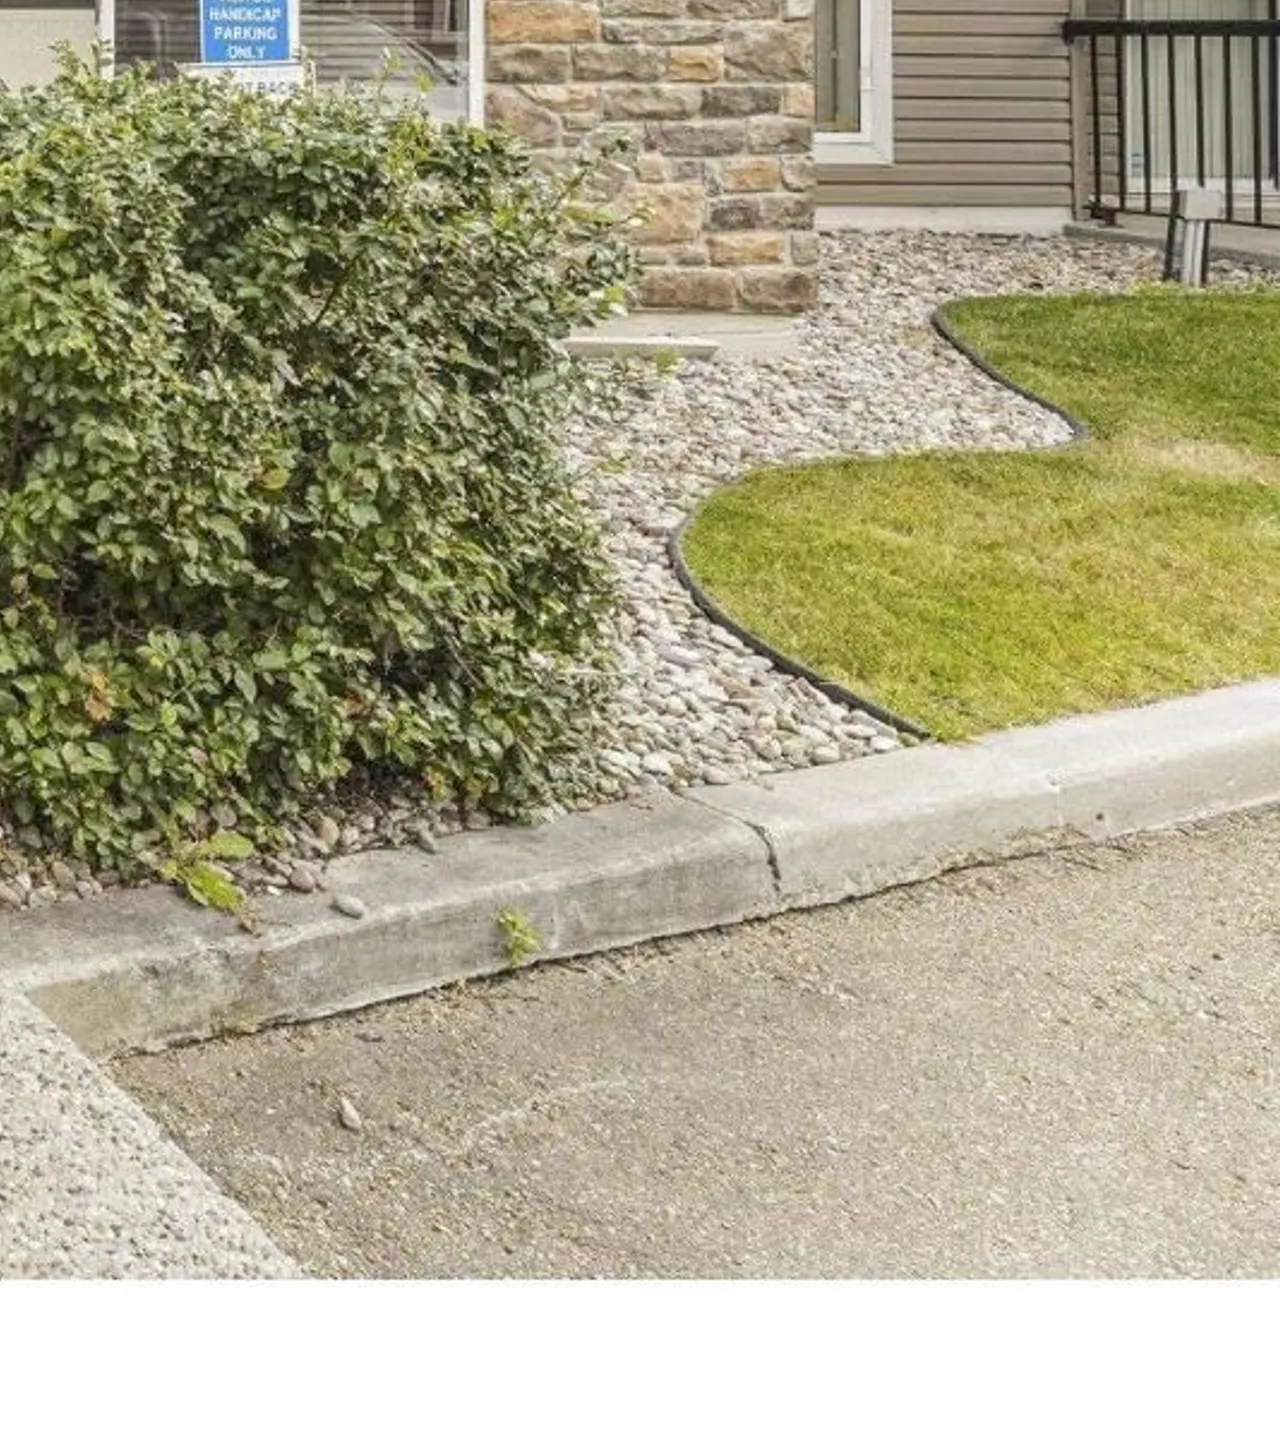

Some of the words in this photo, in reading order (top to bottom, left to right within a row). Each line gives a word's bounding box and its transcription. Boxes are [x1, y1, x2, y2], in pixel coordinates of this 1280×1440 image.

[209, 7, 281, 21] HANDICAP
[214, 26, 278, 41] PARKING
[227, 46, 266, 60] ONLY
